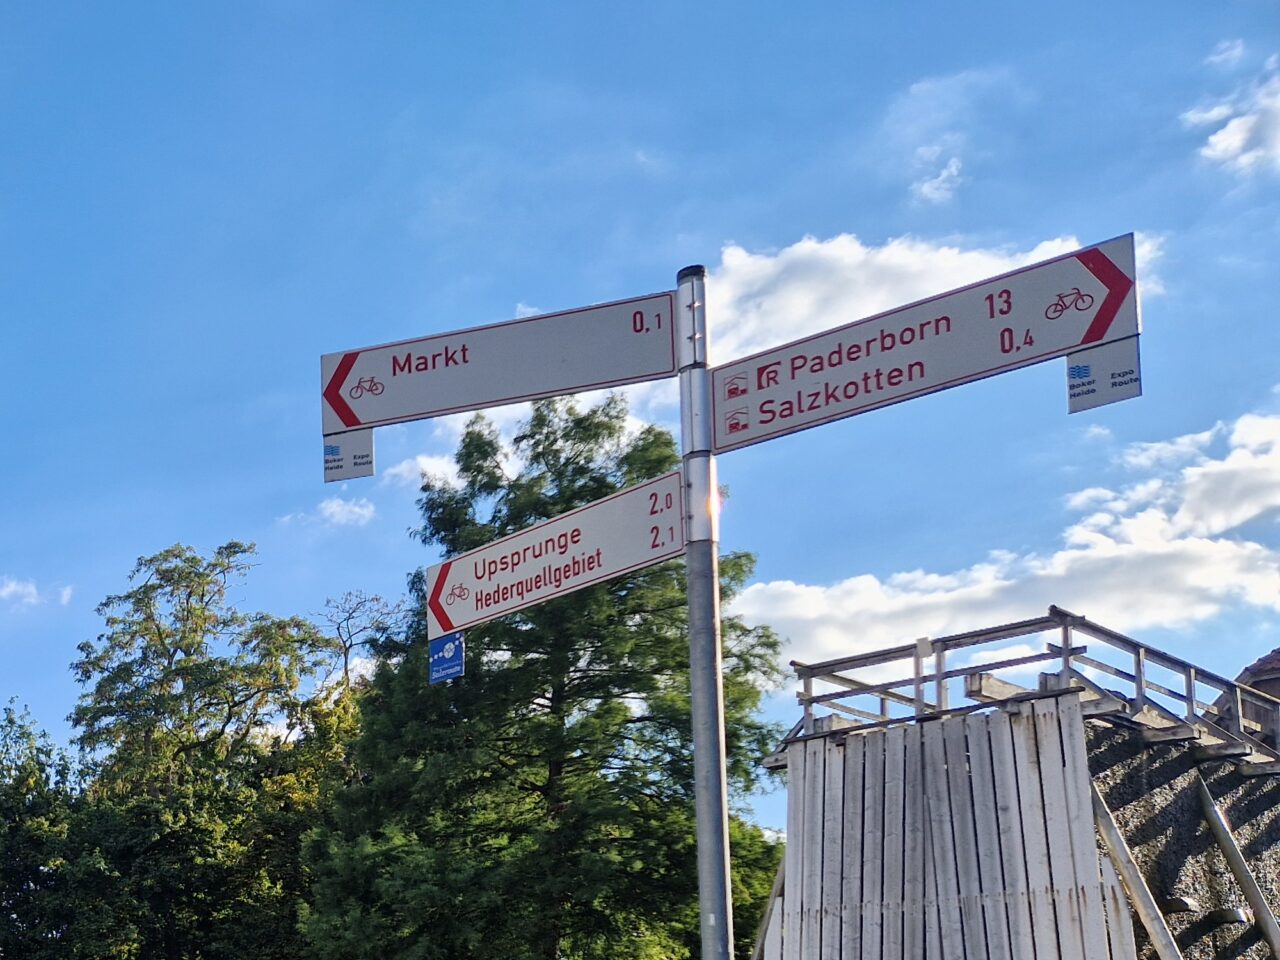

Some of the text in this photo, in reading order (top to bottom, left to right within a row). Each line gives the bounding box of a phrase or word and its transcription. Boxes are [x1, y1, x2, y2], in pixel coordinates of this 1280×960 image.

[391, 310, 662, 377] Markt 0,1
[758, 328, 1034, 426] Salzkotten 0,4
[791, 314, 951, 380] Paderborn
[984, 289, 1013, 319] 13
[1110, 369, 1135, 379] Expo
[1111, 377, 1139, 388] Route
[474, 492, 673, 581] Upsprunge 2,0
[475, 526, 674, 611] Hederquellgebiet 2,1
